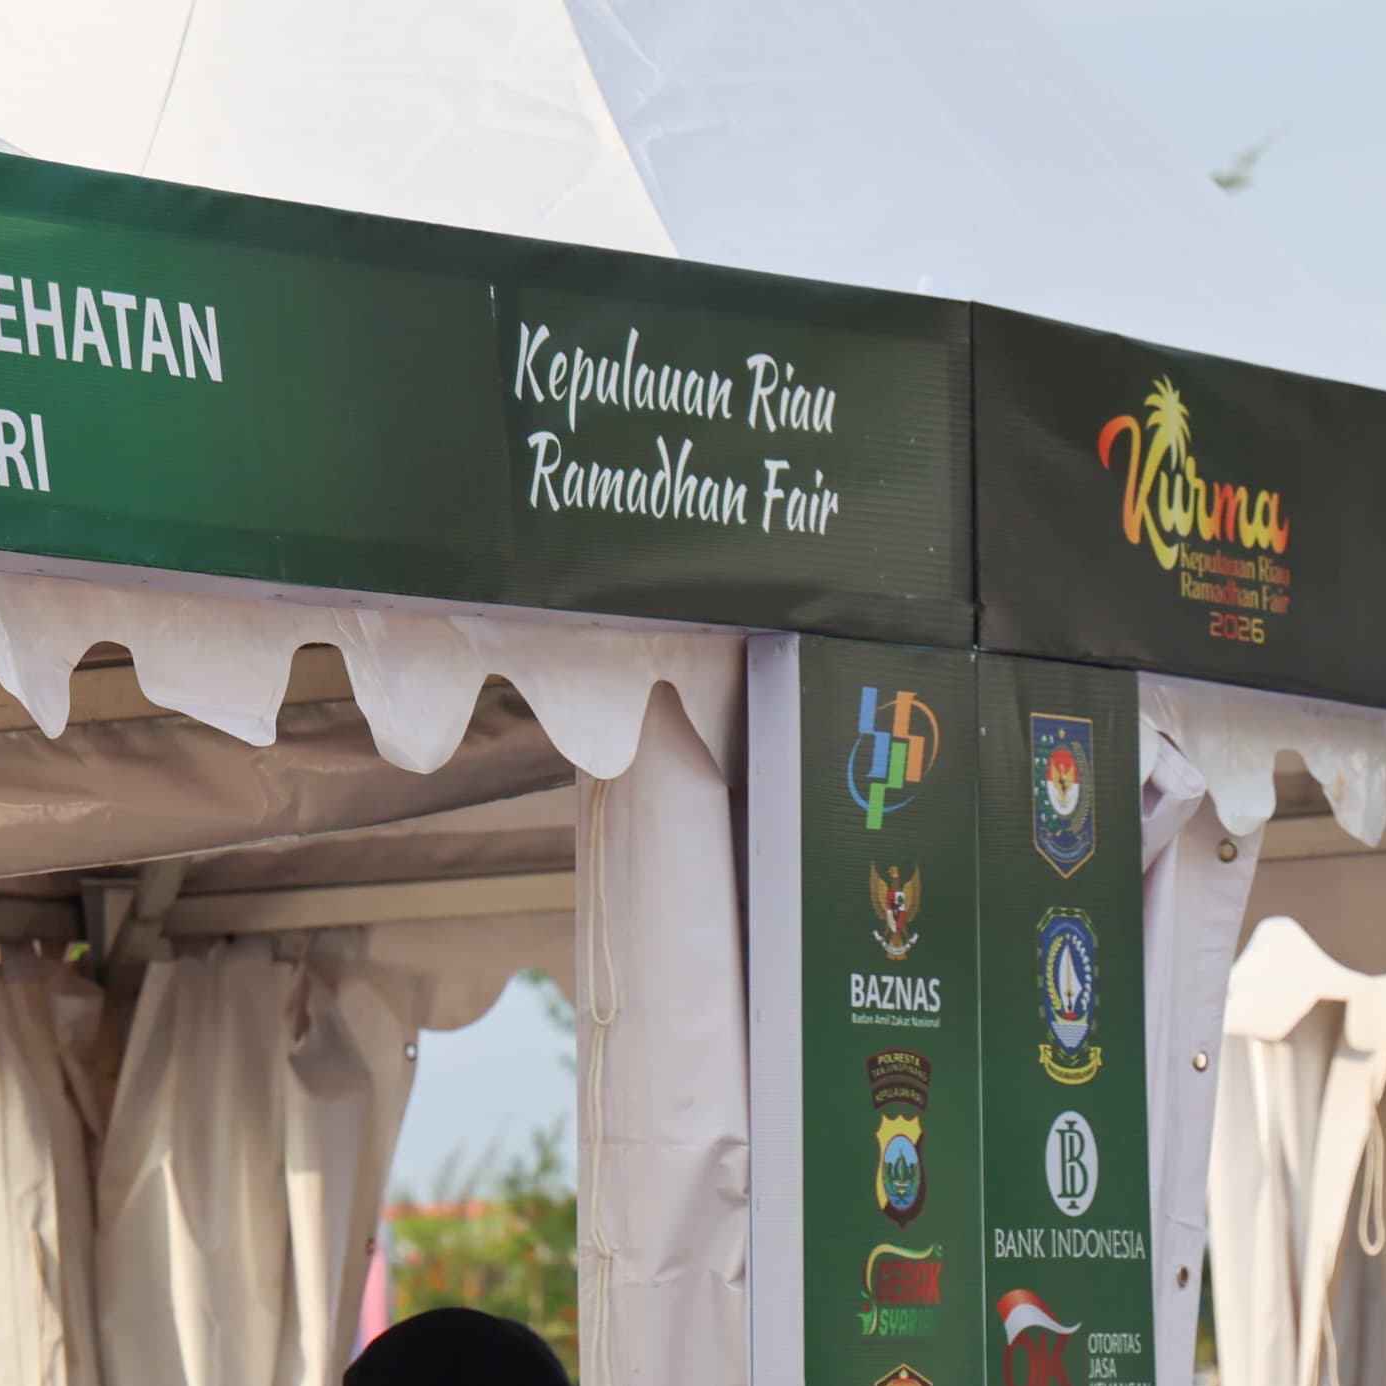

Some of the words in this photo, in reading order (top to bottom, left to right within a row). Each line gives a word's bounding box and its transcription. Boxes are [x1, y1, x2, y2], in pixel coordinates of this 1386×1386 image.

[514, 321, 733, 432] Kepulauan
[747, 353, 836, 433] Riau
[527, 431, 747, 526] Ramadhan
[763, 459, 839, 535] Fair
[1097, 374, 1291, 570] Kurma
[1180, 542, 1255, 581] Kepulauan
[1259, 554, 1291, 586] Riau
[1181, 570, 1259, 610] Ramadhan
[1261, 587, 1290, 615] Fair
[1209, 611, 1265, 644] 2026
[850, 973, 941, 1013] BAZNAS
[994, 1228, 1046, 1259] BANK
[1051, 1228, 1146, 1259] INDONESIA
[1088, 1332, 1142, 1354] OTORITAS
[1088, 1357, 1117, 1379] JASA
